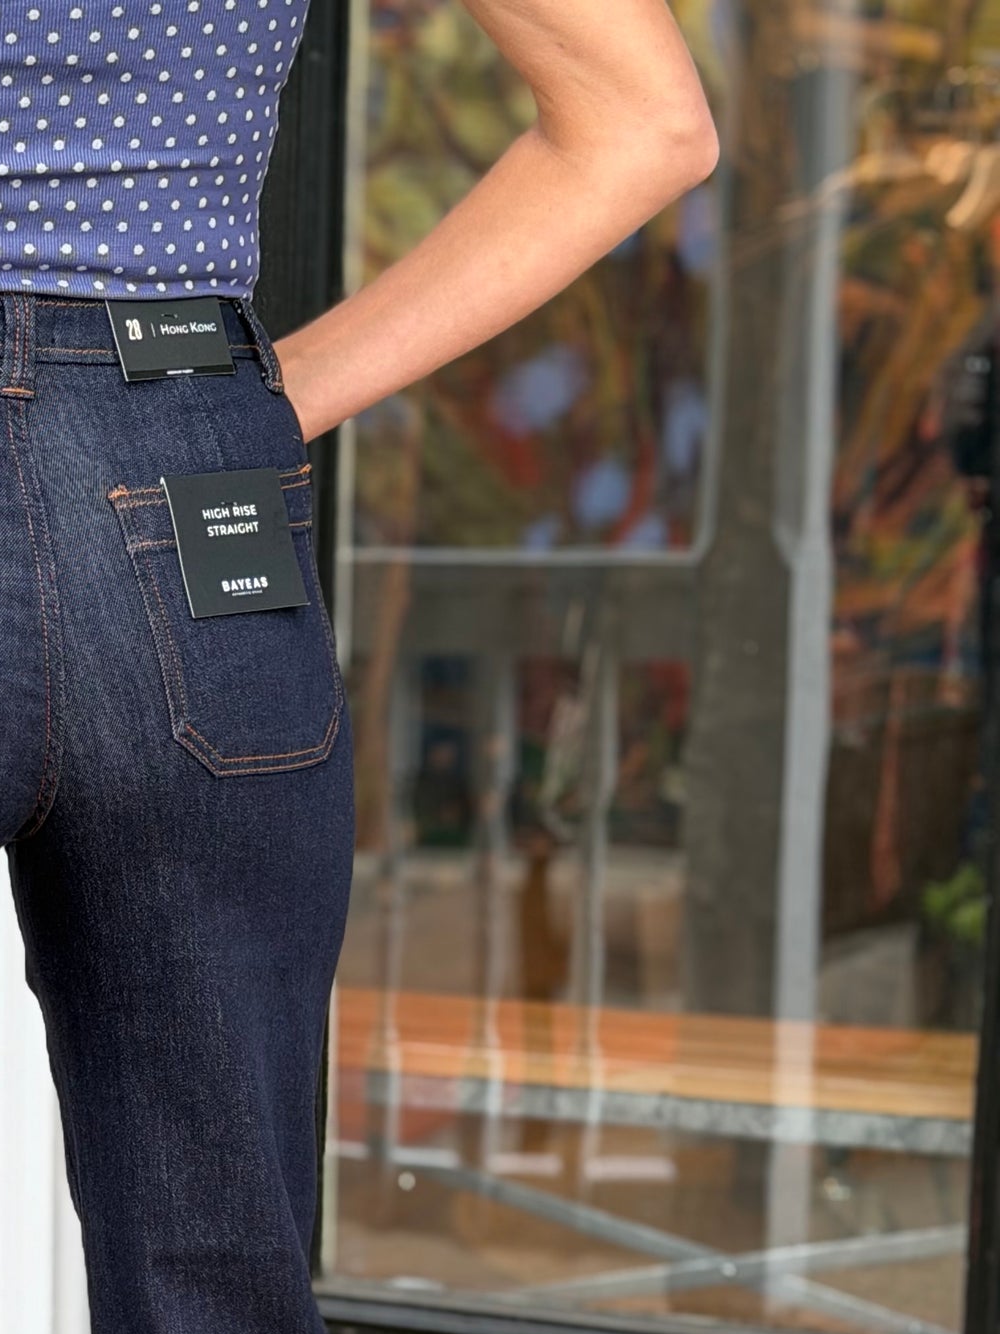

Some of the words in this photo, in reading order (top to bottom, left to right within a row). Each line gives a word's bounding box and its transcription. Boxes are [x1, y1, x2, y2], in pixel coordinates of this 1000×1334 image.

[202, 507, 231, 520] HIGH
[232, 504, 258, 516] RISE
[206, 521, 260, 537] STRAIGHT
[221, 576, 269, 592] BAYEAS
